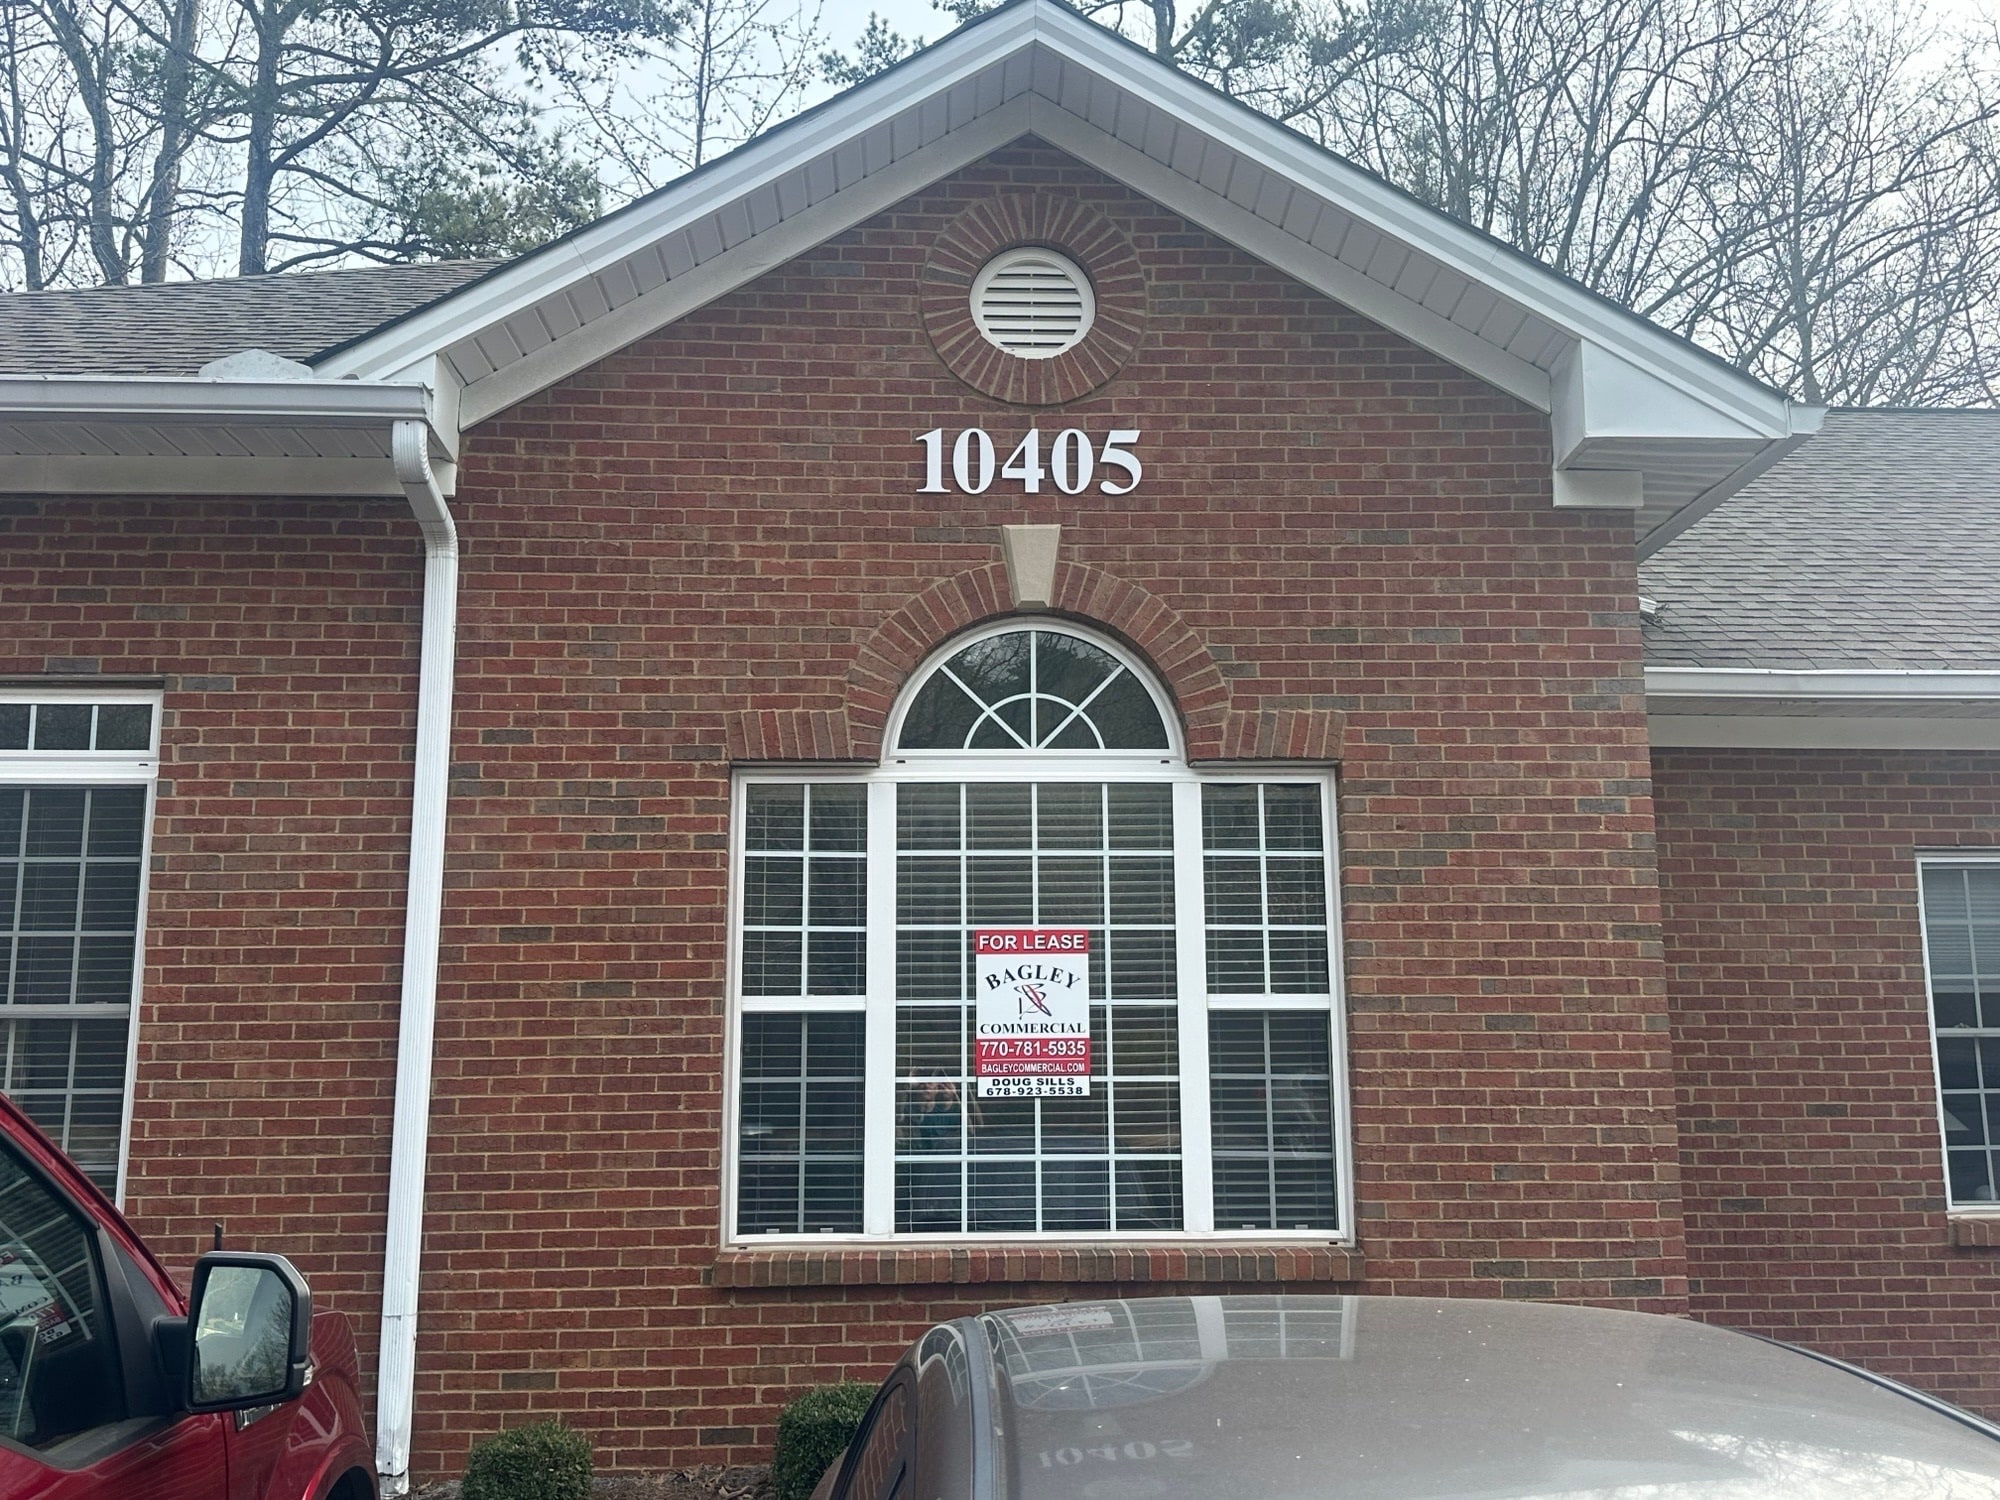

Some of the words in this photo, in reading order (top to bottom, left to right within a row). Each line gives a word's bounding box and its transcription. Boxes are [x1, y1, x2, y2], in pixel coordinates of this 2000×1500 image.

[916, 428, 1142, 495] 10405
[979, 935, 1017, 950] FOR
[1023, 934, 1085, 950] LEASE
[985, 964, 1081, 991] BAGLEY
[980, 1023, 1086, 1034] COMMERCIAL
[980, 1041, 1086, 1057] 770-781-5935
[981, 1063, 1085, 1073] BAGLEYCOMMERCIAL.COM
[992, 1078, 1032, 1086] DOUG
[1036, 1077, 1075, 1086] SILLS
[986, 1087, 1083, 1096] 678-923-5538
